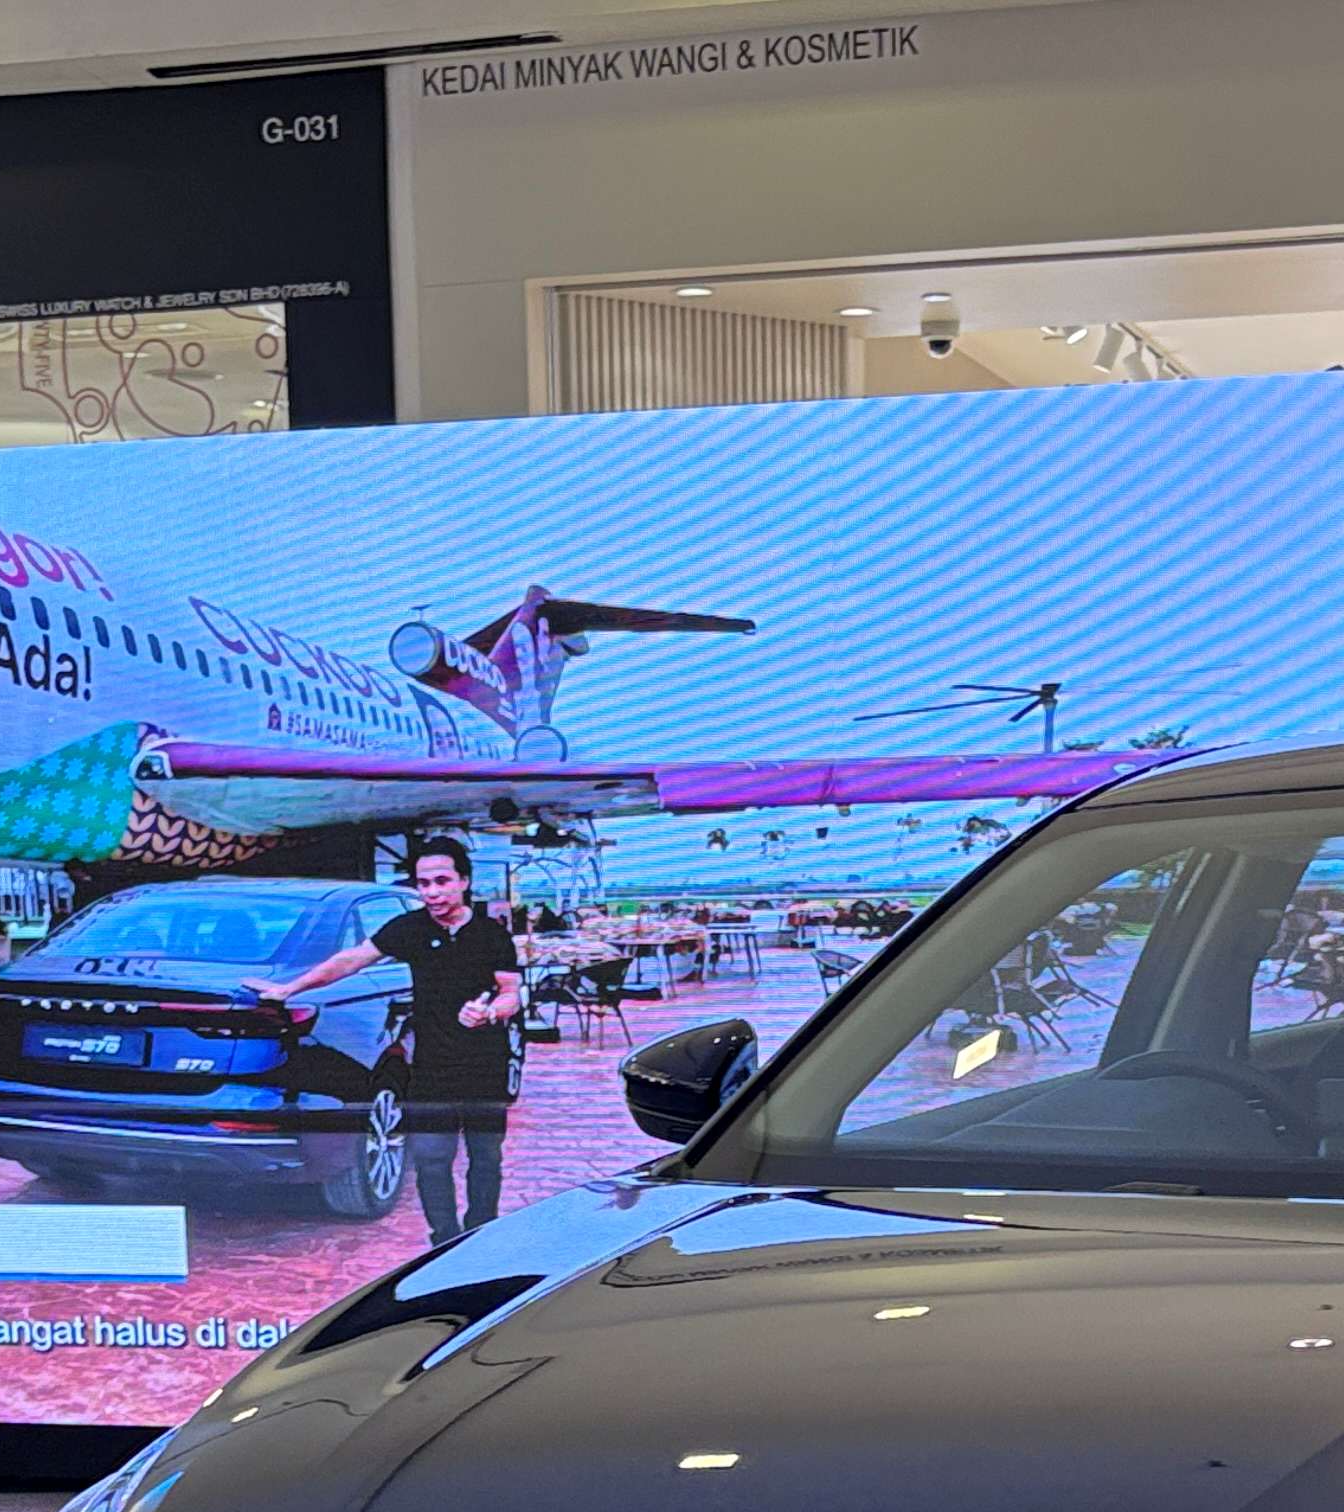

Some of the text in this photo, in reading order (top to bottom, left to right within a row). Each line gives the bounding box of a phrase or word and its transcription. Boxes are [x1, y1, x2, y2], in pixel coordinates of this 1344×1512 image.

[422, 25, 920, 97] KEDAI MINYAK WANGI & KOSMETIK
[262, 115, 340, 143] G-031
[41, 300, 92, 315] LUXURY
[188, 596, 402, 708] CUCKOO
[94, 1317, 186, 1348] halus
[195, 1318, 225, 1348] di
[237, 1318, 299, 1349] dal
